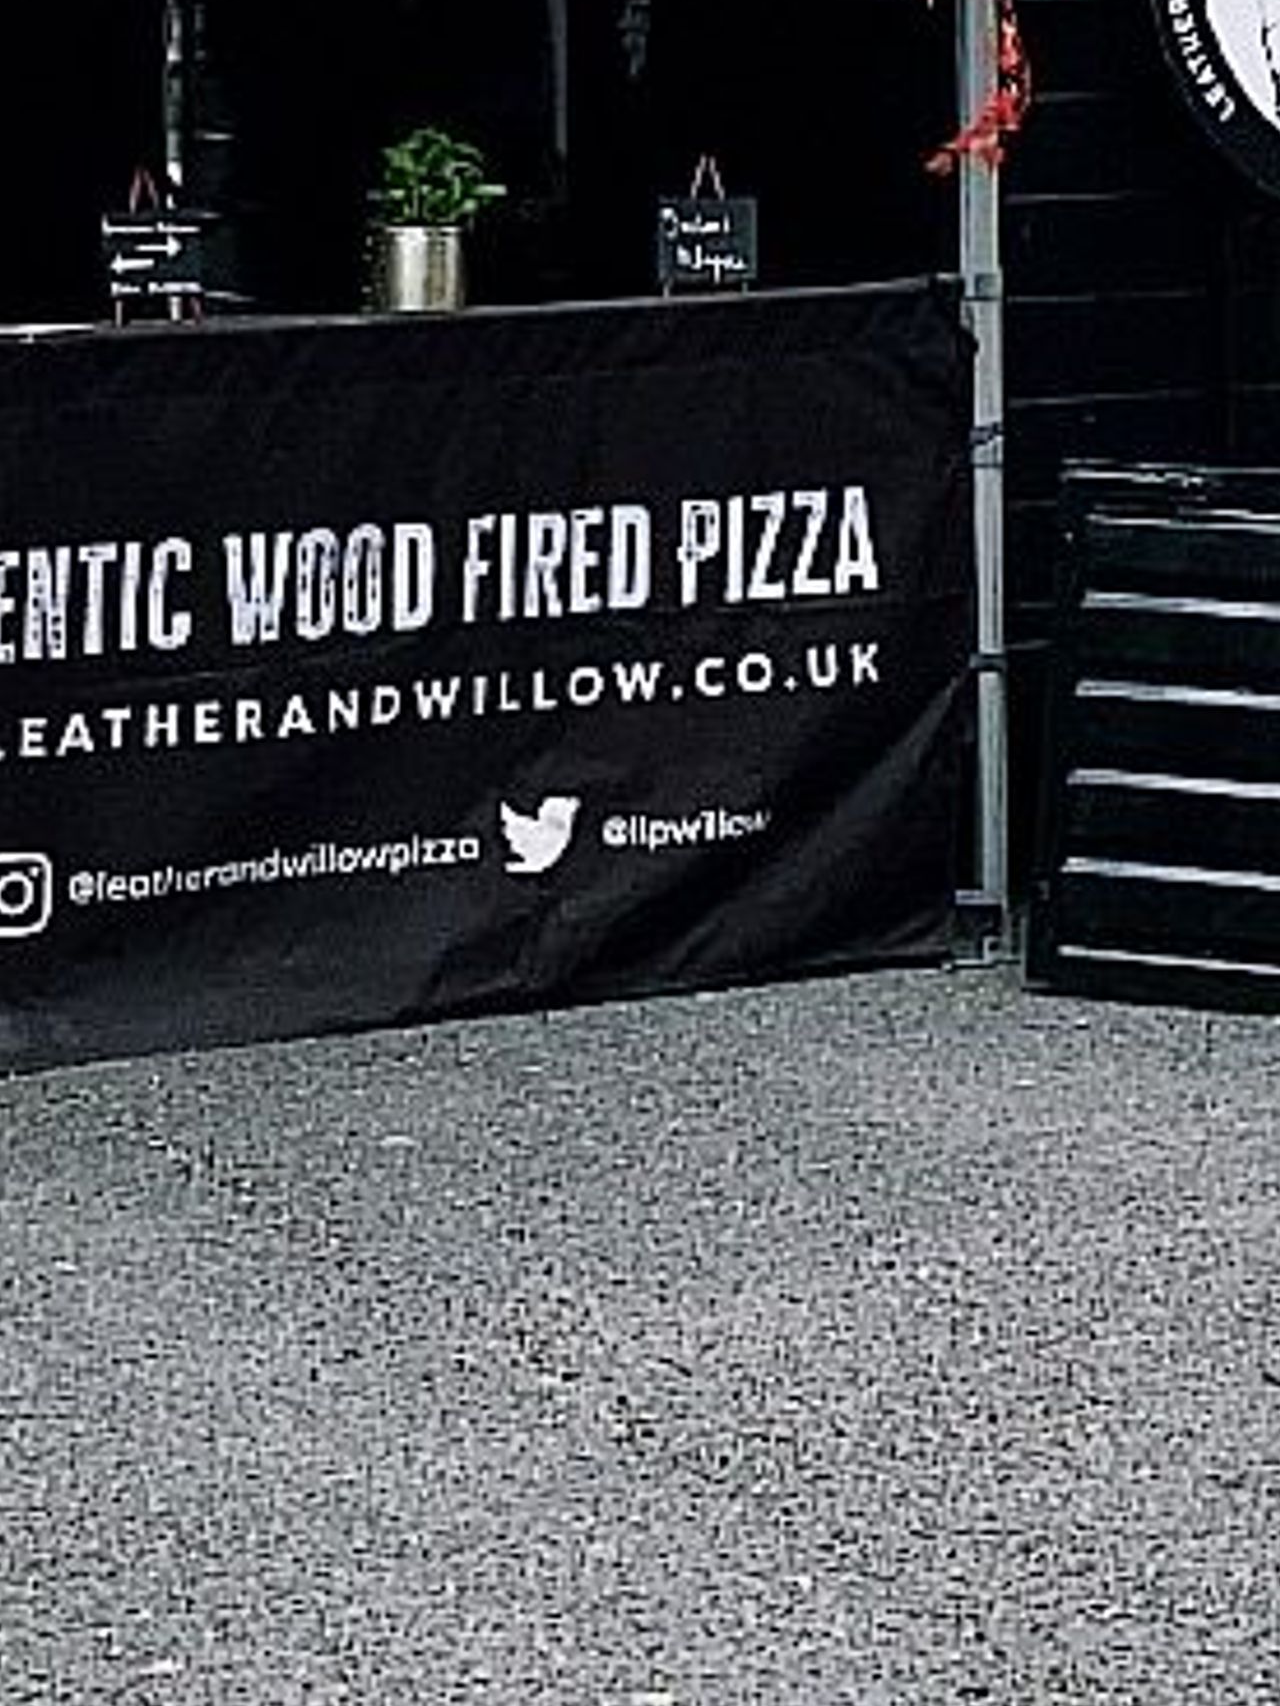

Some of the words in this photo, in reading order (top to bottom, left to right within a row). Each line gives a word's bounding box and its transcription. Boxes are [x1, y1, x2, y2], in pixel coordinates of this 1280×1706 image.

[223, 523, 434, 645] WOOD
[463, 505, 651, 623] FIRED
[676, 486, 878, 606] PIZZA
